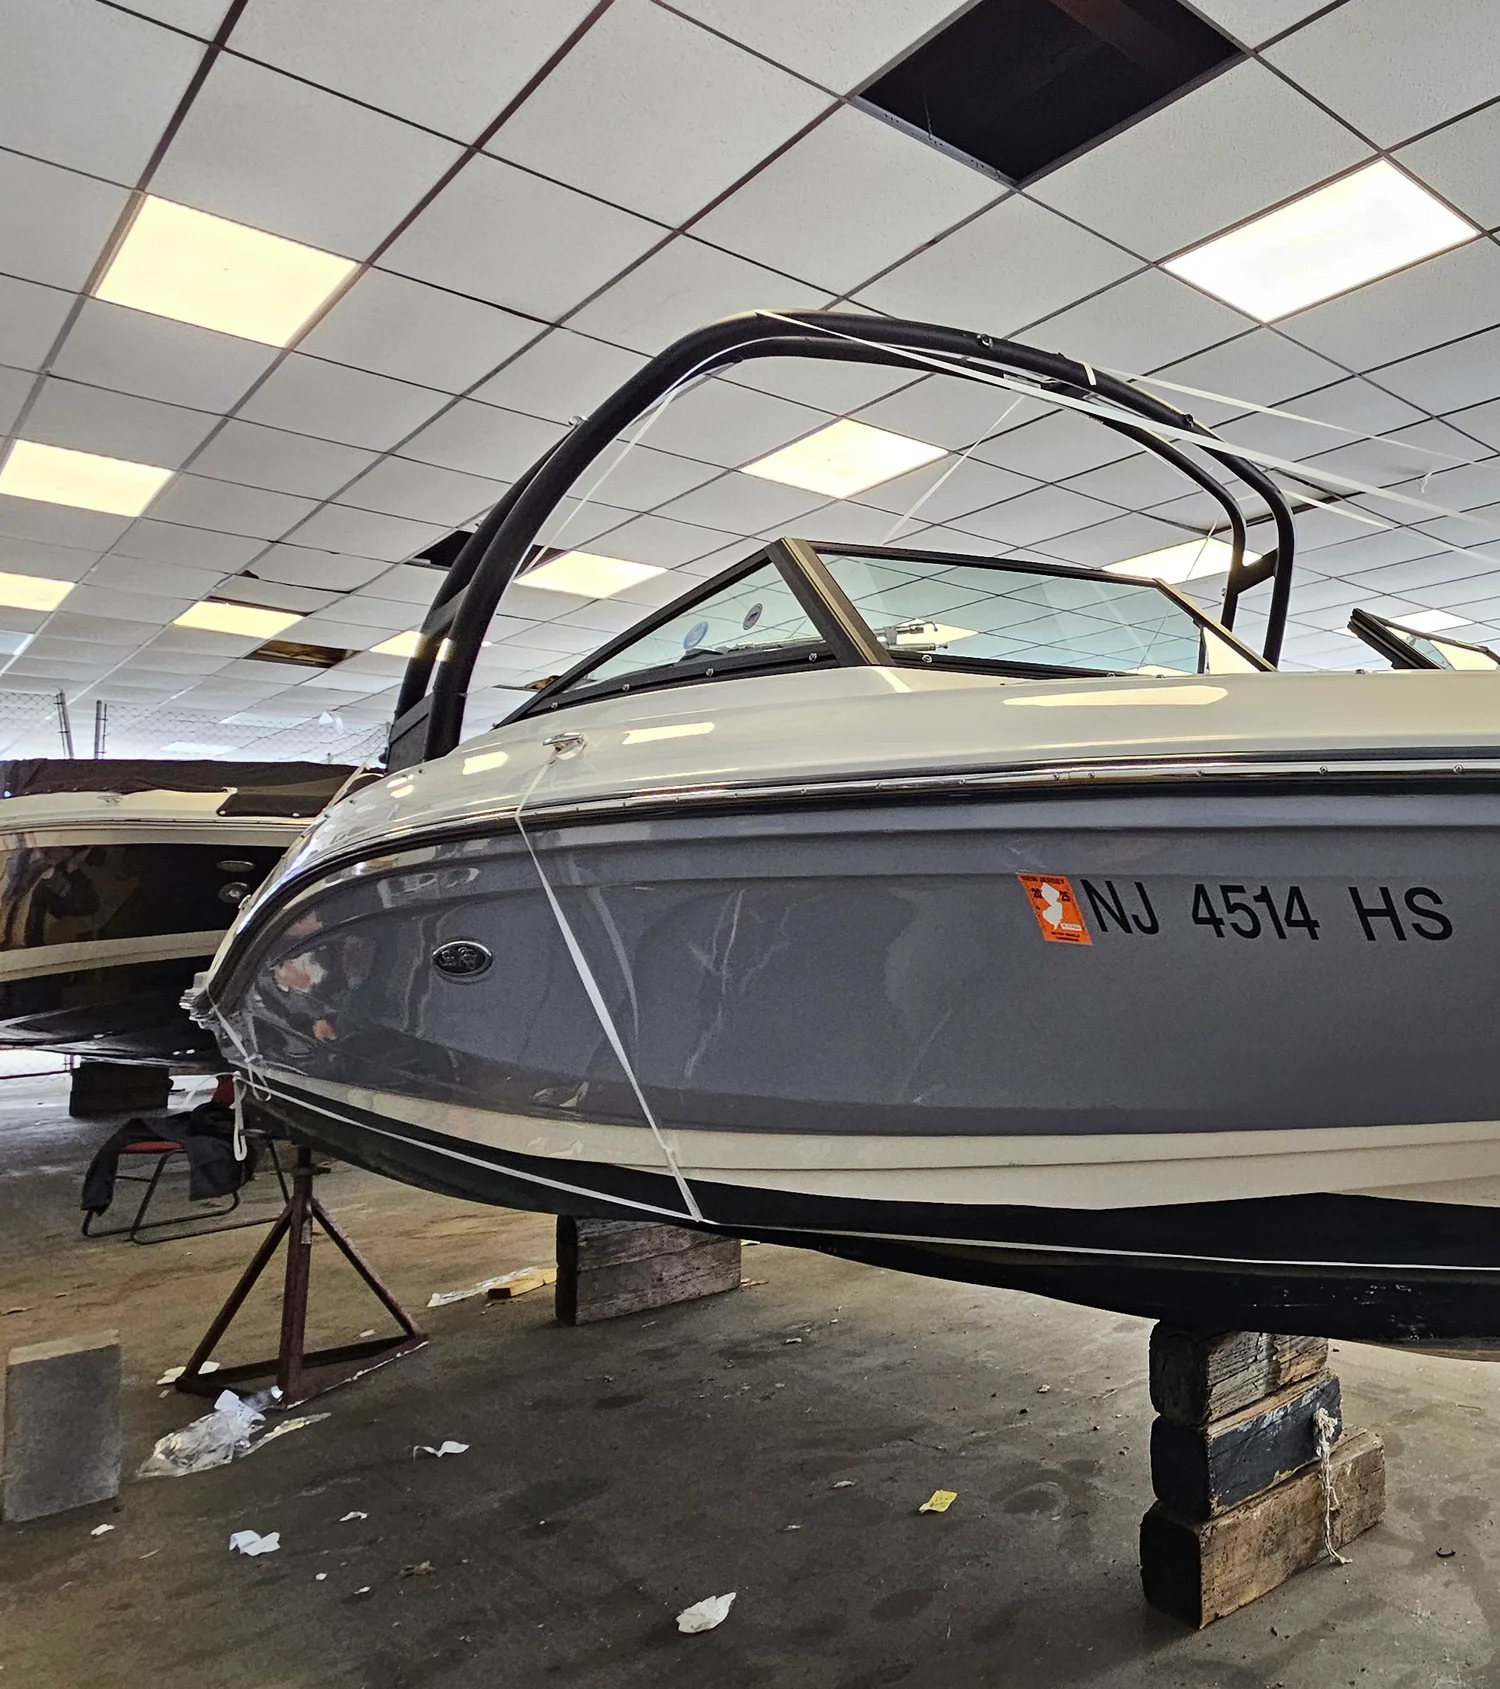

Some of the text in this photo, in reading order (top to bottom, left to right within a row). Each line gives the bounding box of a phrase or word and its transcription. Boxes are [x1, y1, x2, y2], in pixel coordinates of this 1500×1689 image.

[1080, 878, 1453, 941] NJ 4514 HS
